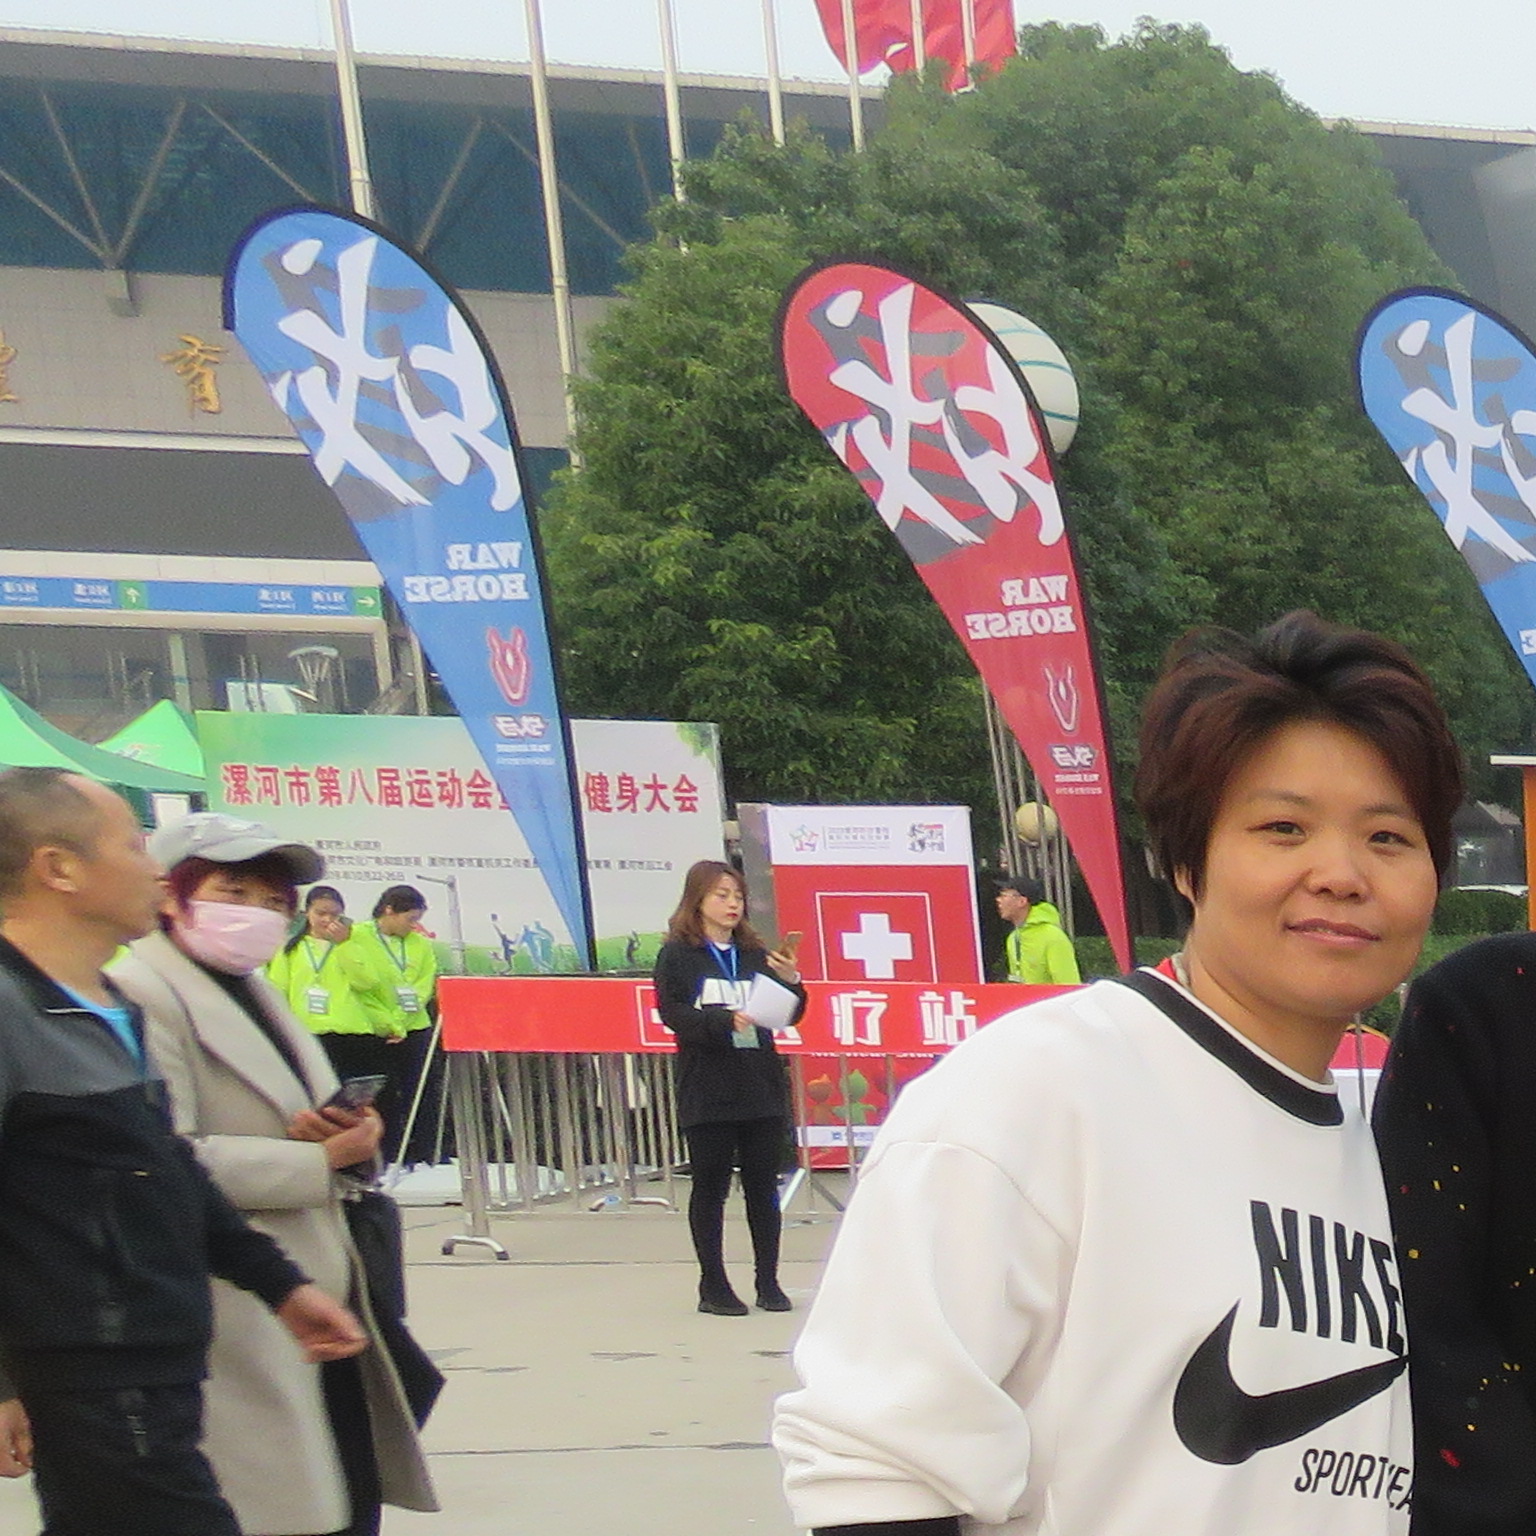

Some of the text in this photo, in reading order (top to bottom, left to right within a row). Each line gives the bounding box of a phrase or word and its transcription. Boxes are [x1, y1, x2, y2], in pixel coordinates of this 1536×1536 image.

[583, 770, 700, 814] 健身大会
[1250, 1199, 1405, 1357] NIKE
